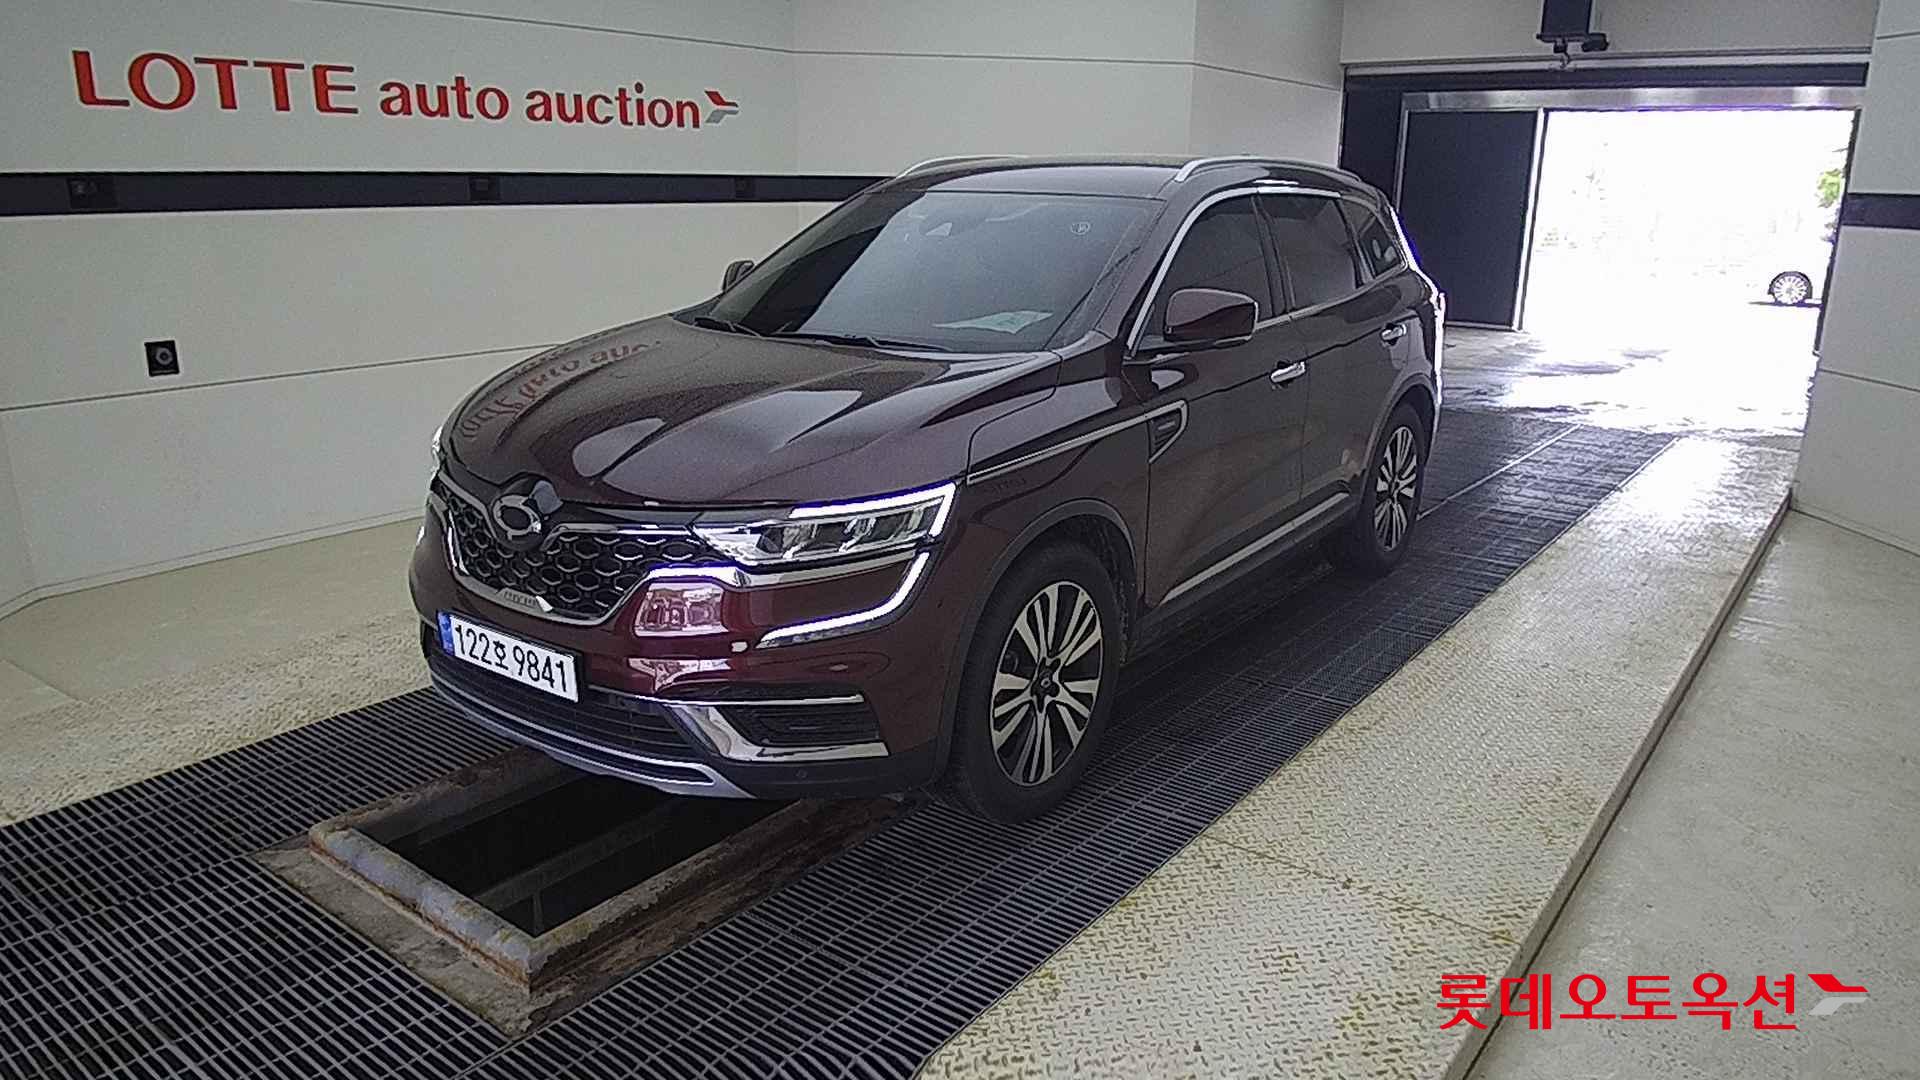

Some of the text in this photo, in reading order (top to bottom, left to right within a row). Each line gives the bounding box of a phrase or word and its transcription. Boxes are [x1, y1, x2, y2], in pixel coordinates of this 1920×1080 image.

[71, 49, 700, 129] LOTTE auto auction
